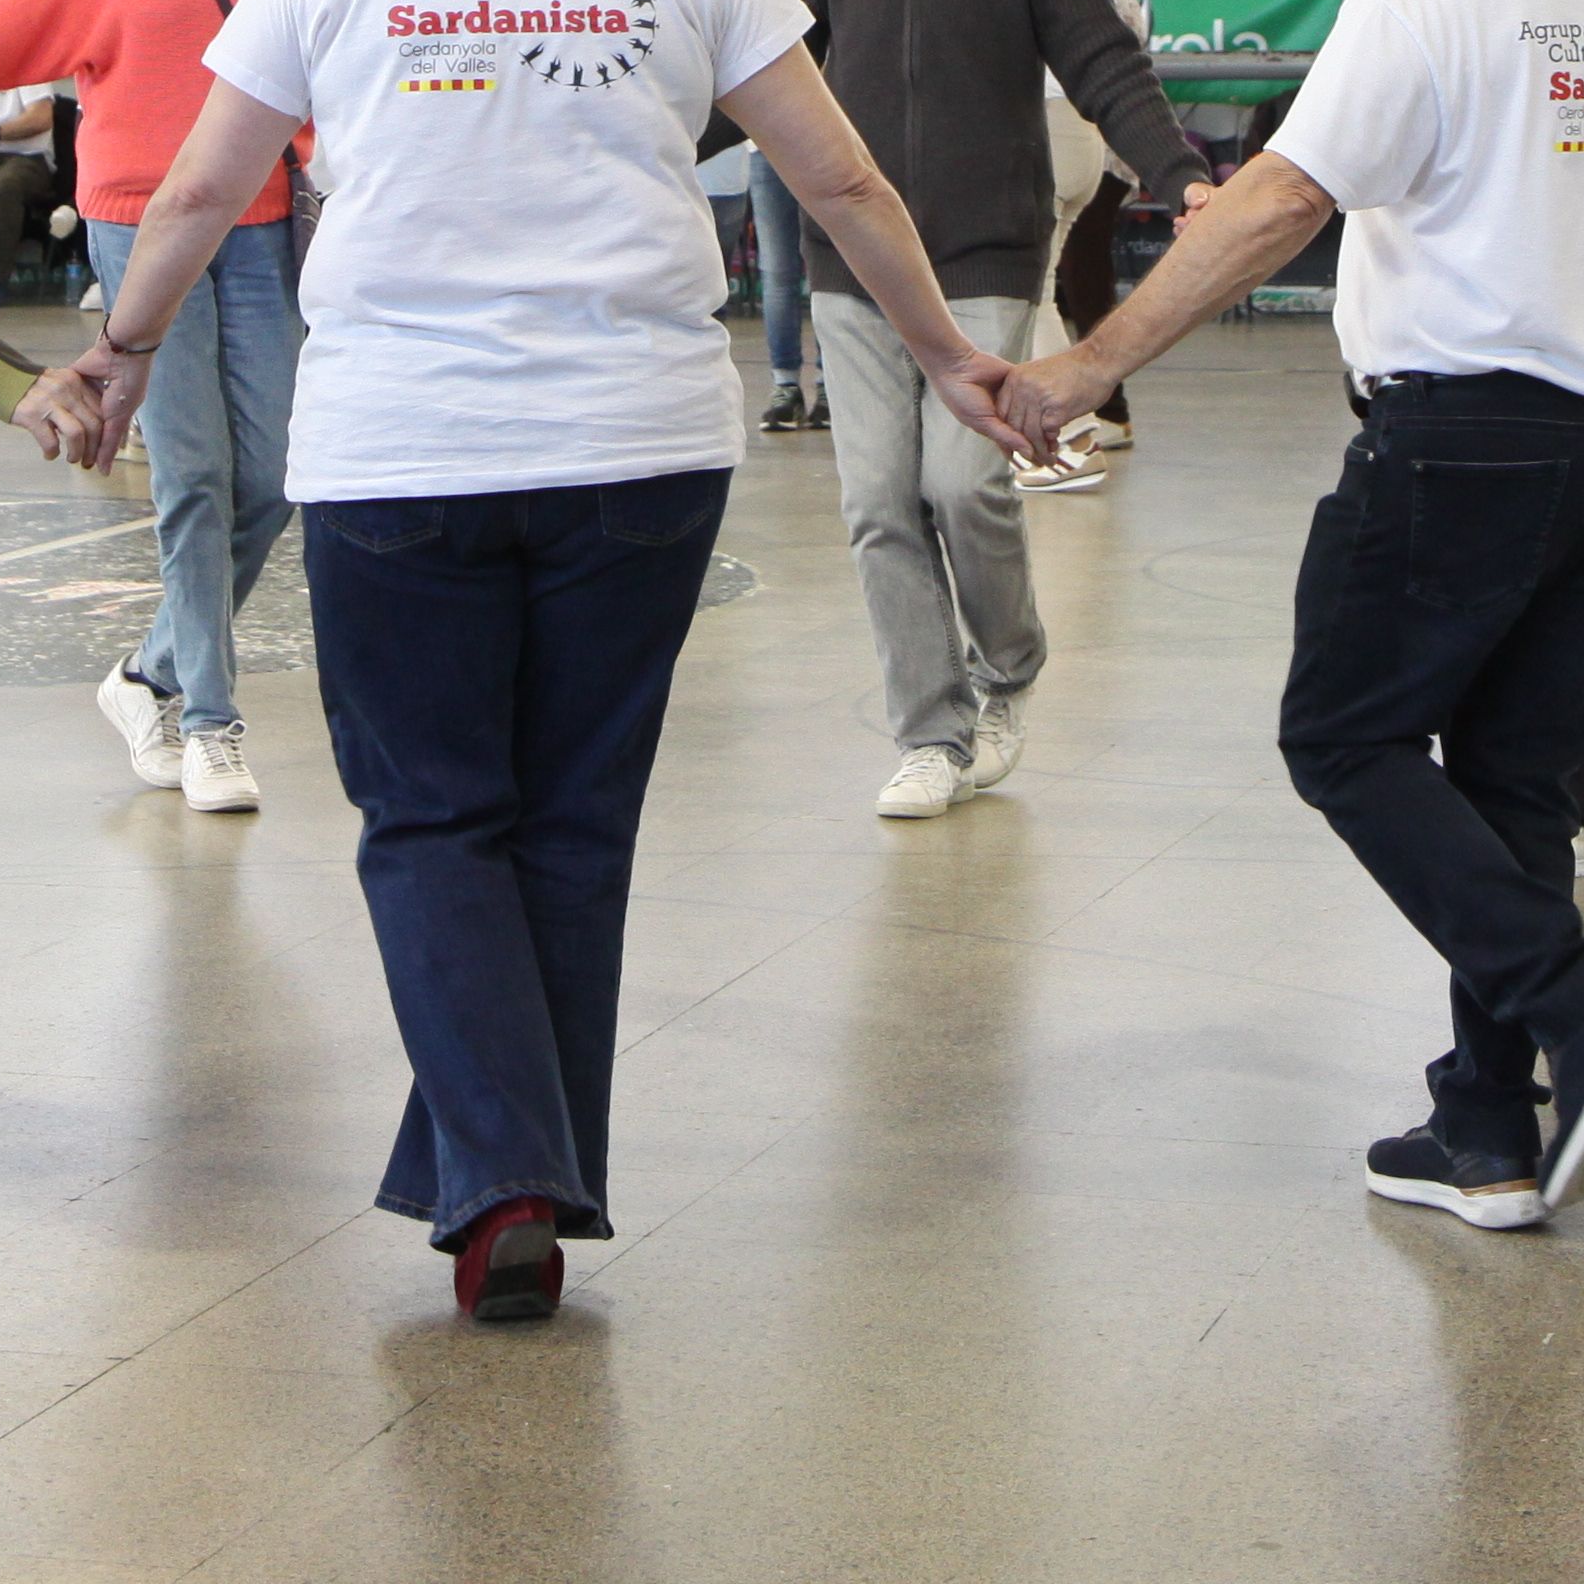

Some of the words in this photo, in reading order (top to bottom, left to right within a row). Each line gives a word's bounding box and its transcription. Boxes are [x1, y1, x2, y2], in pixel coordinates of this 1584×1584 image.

[387, 0, 630, 37] Sardanista
[399, 40, 496, 59] Cerdanyola
[411, 58, 437, 74] del
[445, 57, 496, 73] Vallès
[1565, 121, 1582, 136] del
